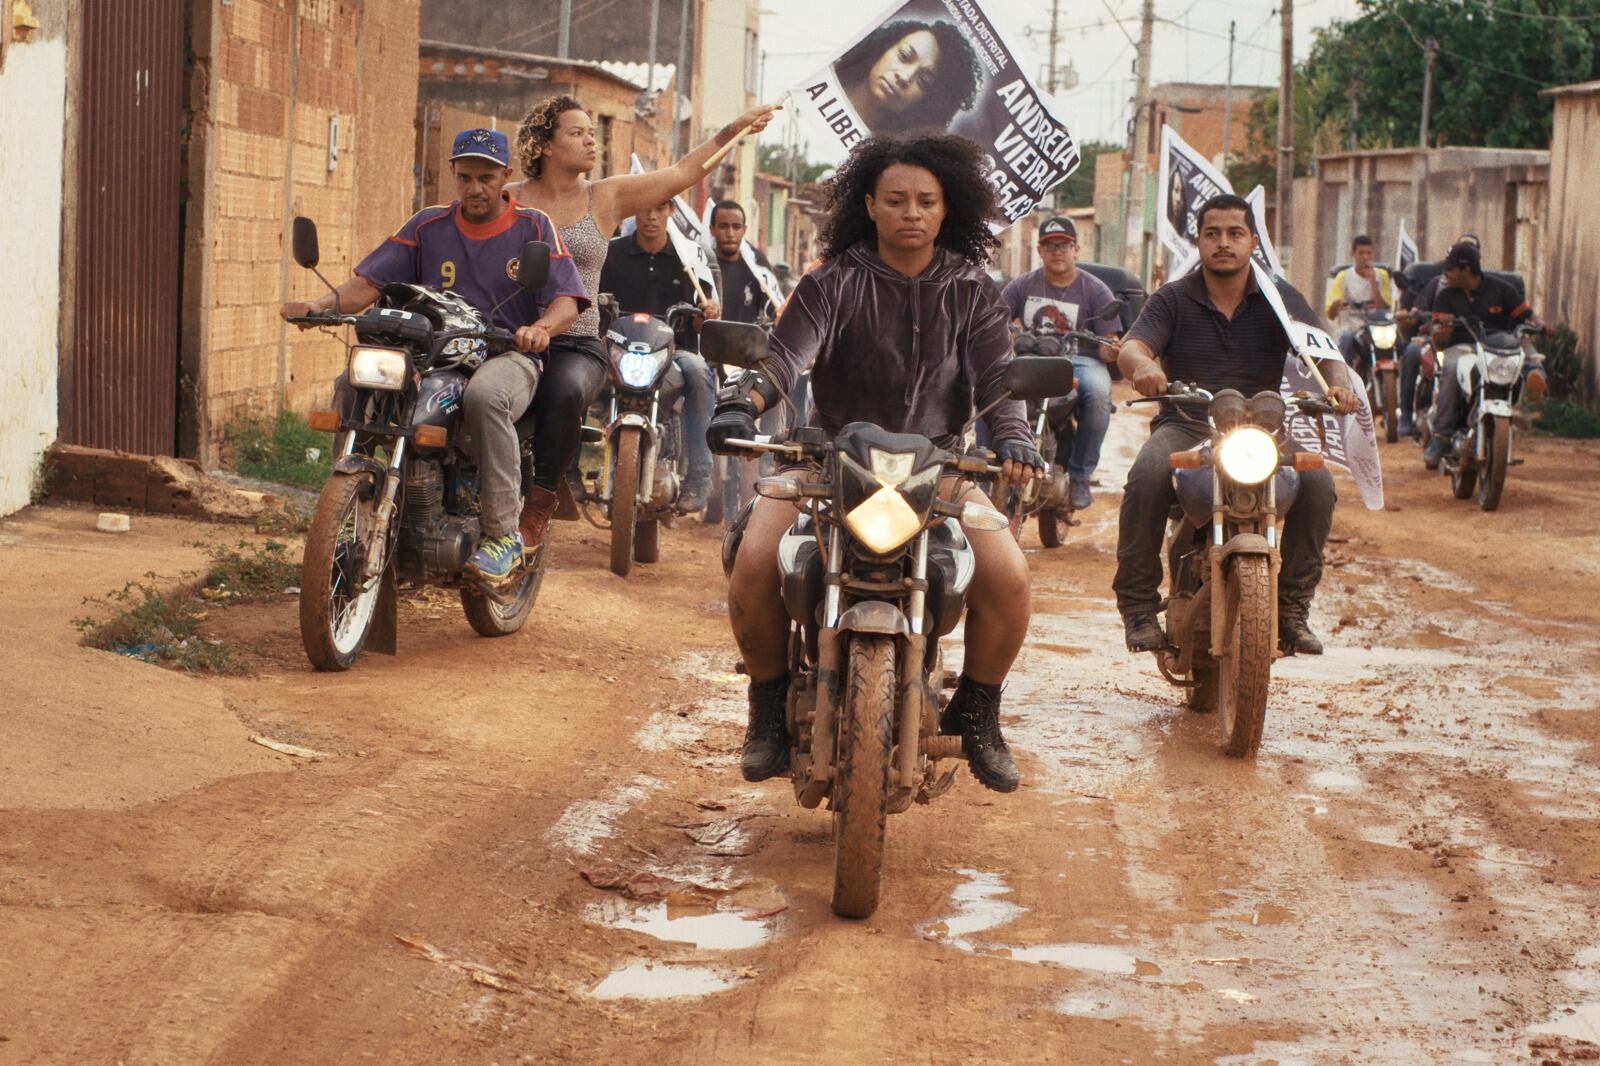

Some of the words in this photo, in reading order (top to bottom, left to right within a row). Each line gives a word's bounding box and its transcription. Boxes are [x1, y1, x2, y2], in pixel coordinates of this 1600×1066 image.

[975, 21, 1009, 69] DISTRITAL
[806, 81, 828, 101] A
[818, 97, 862, 153] LIBE
[996, 79, 1076, 171] ANDREIA
[994, 122, 1058, 196] VIEIRA
[441, 260, 456, 288] 9
[1306, 332, 1321, 348] A
